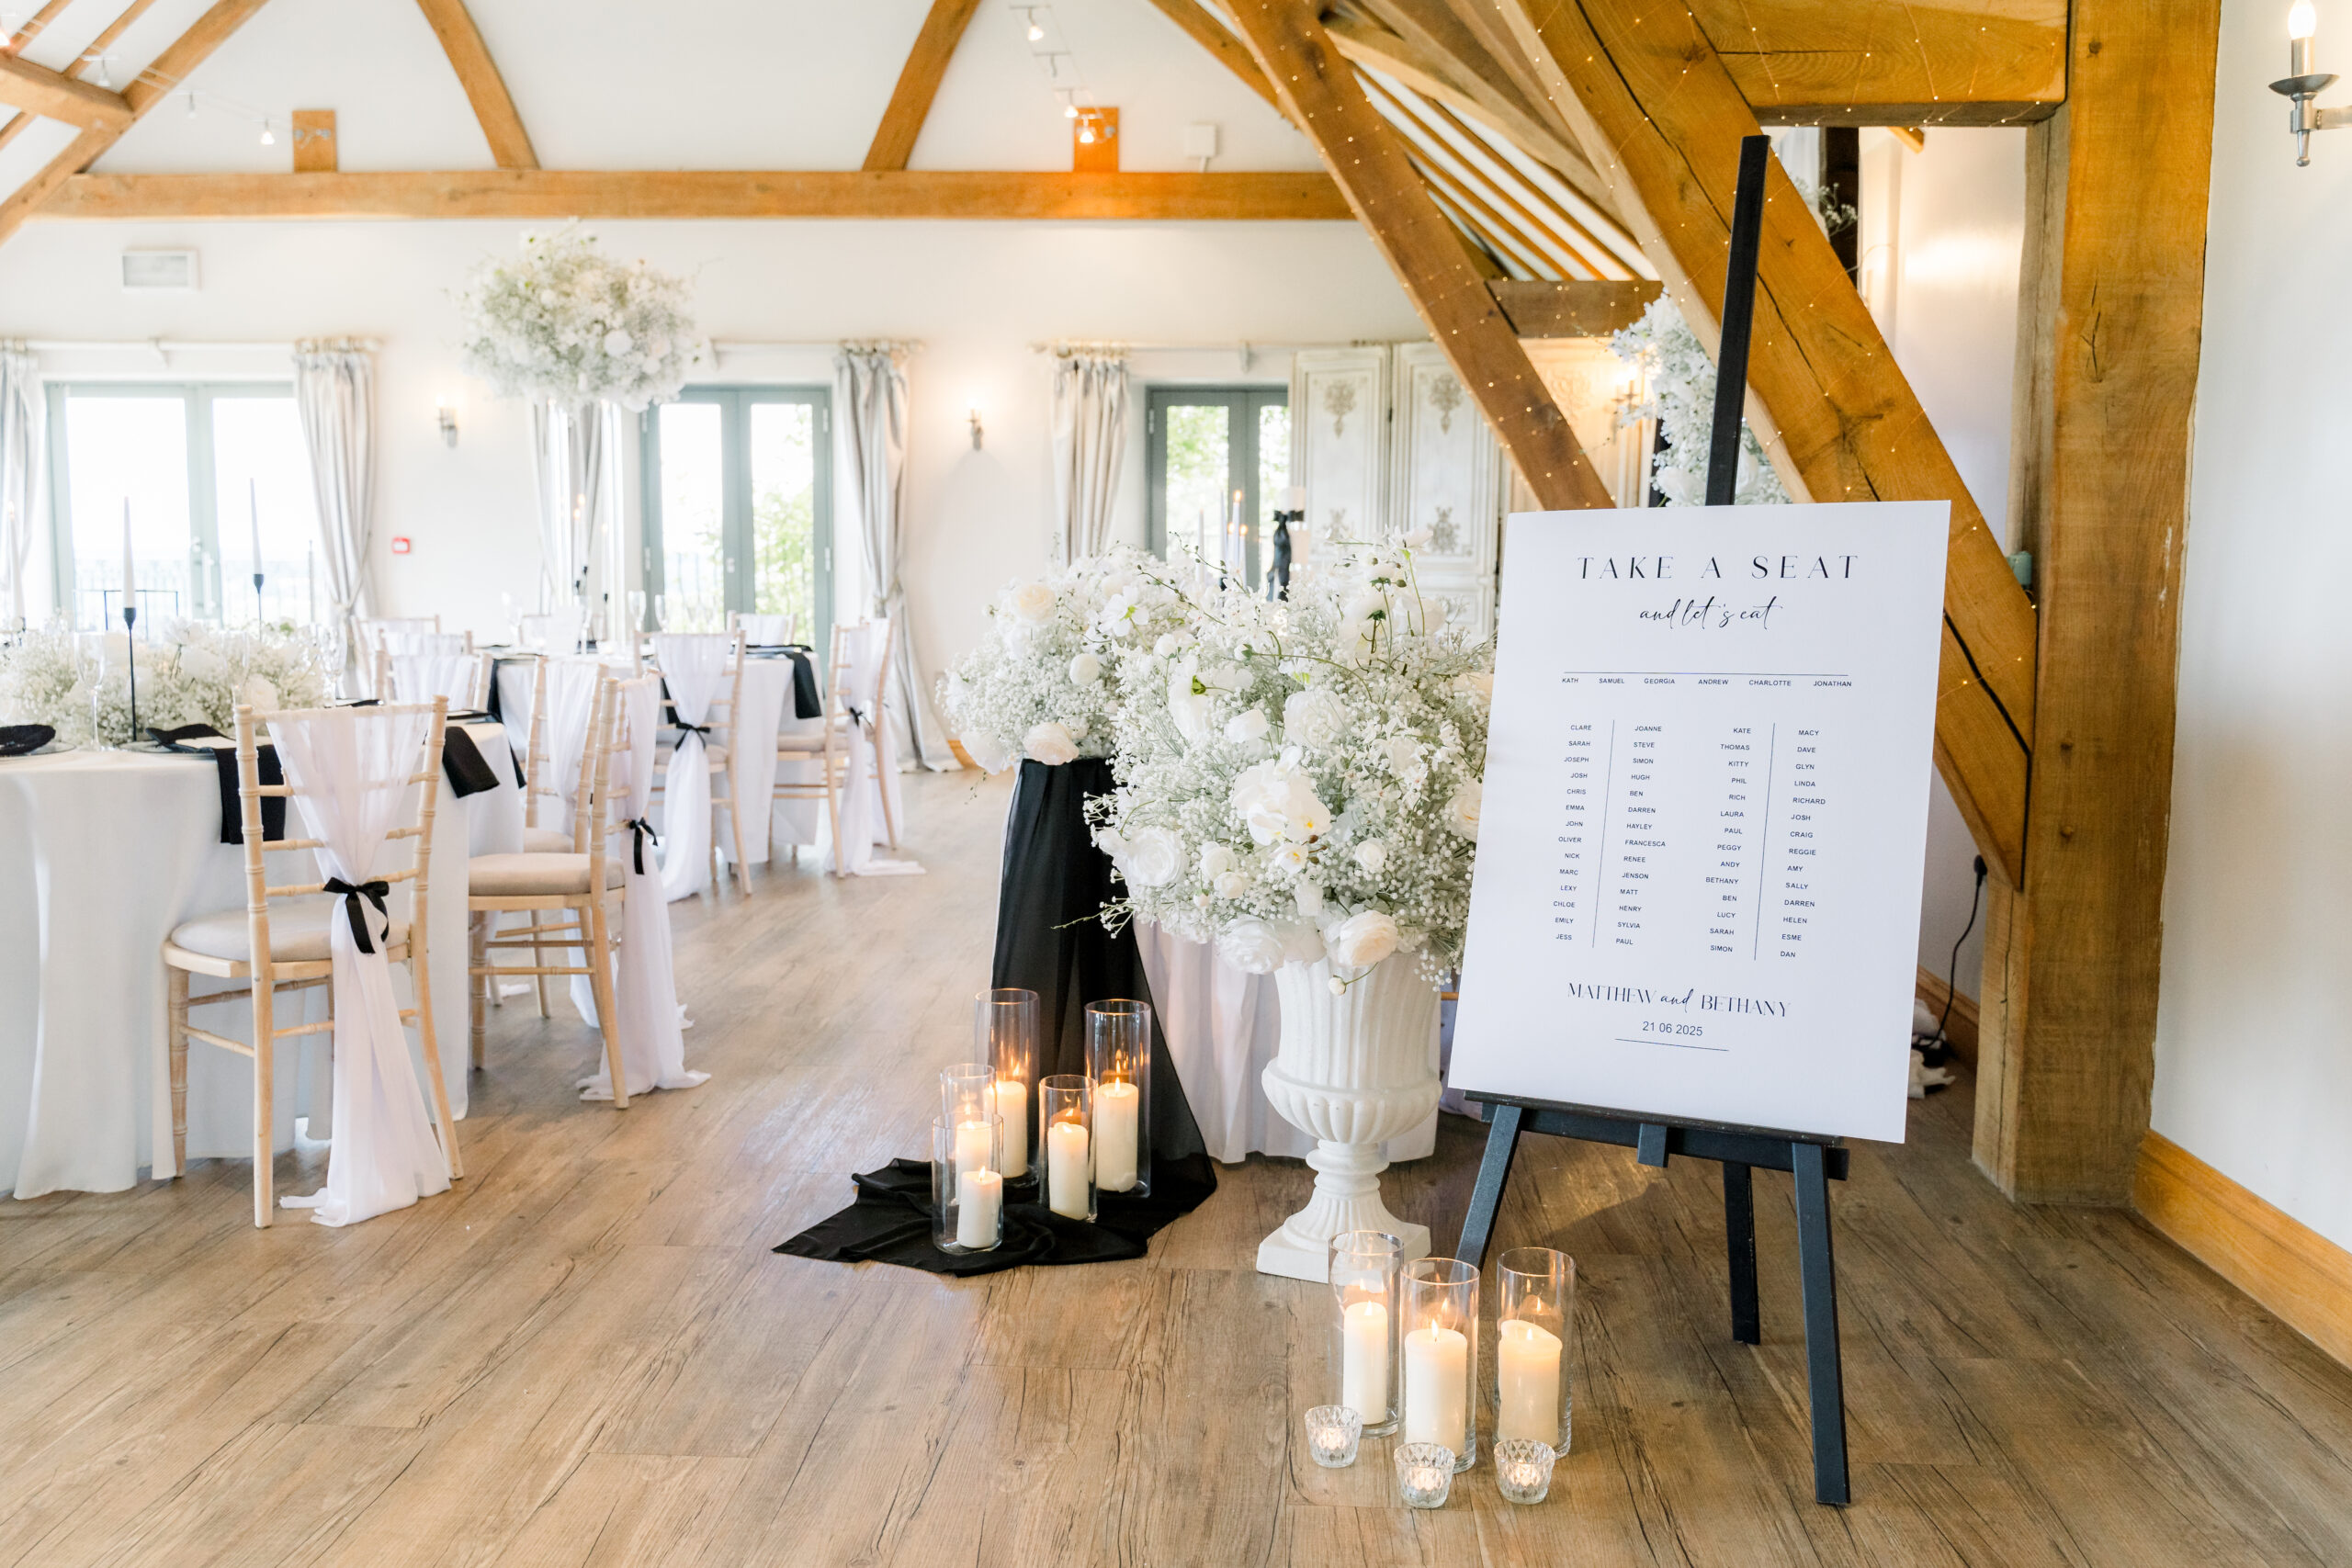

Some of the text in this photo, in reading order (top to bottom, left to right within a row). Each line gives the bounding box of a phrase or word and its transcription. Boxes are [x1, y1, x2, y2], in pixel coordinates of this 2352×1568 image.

[1577, 554, 1859, 580] TAKE A SEAT
[1639, 595, 1783, 630] and let's eat
[1748, 679, 1792, 687] CHARLOTTE
[1720, 743, 1750, 751] THOMAS
[1792, 796, 1826, 806] RICHARD
[1724, 827, 1743, 835] PAUL
[1790, 830, 1814, 839] CRAIG
[1624, 839, 1667, 847] FRANCESCA
[1716, 843, 1742, 852] PEGGY
[1788, 848, 1816, 856] REGGIE
[1623, 855, 1646, 863] RENEE
[1559, 868, 1578, 876] MARC
[1787, 864, 1804, 873] AMY
[1621, 872, 1649, 880] JENSON
[1705, 876, 1739, 885] BETHANY
[1785, 882, 1809, 890] SALLY
[1553, 900, 1576, 908] CHLOE
[1783, 898, 1815, 908] DARREN
[1782, 916, 1808, 924] HELEN
[1709, 928, 1735, 936] SARAH
[1781, 933, 1802, 942] ESME
[1710, 944, 1734, 953] SIMON
[1780, 950, 1796, 958] DAN
[1566, 982, 1792, 1018] MATTHEW and BETHANY
[1642, 1021, 1703, 1037] 21 06 2025
